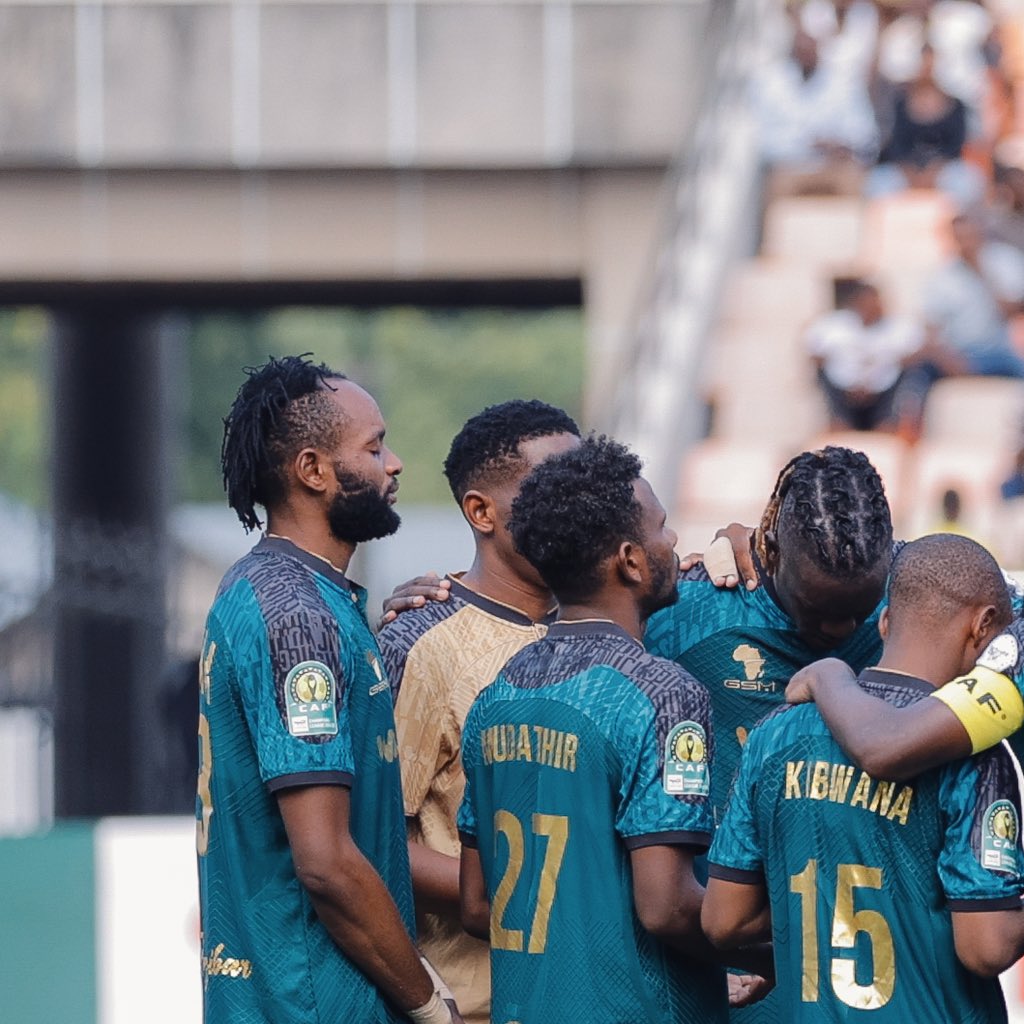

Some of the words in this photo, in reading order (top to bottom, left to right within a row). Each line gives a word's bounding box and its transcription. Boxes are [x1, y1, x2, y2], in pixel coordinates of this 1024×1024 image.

[724, 680, 775, 692] GSM
[298, 703, 329, 713] CAF
[675, 764, 705, 773] CAF
[785, 761, 913, 825] KIBWANA
[490, 810, 568, 954] 27
[790, 859, 896, 1010] 15
